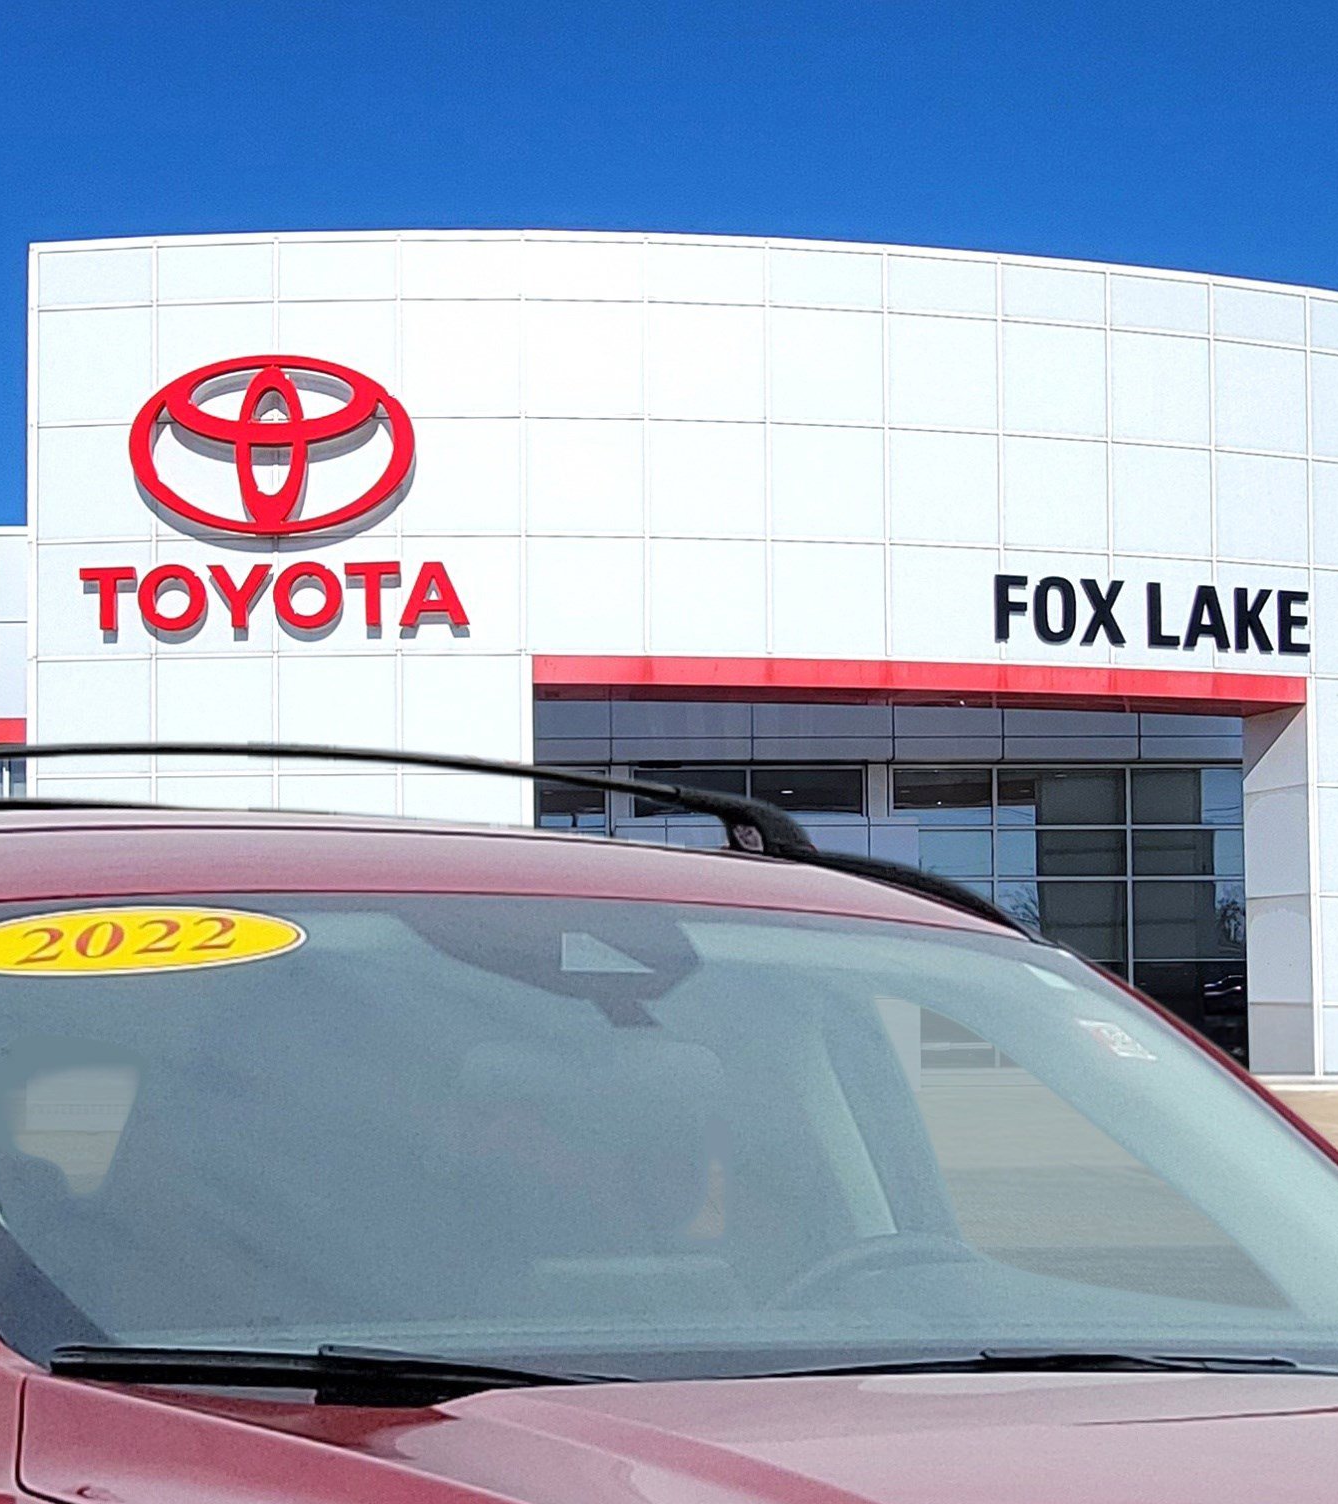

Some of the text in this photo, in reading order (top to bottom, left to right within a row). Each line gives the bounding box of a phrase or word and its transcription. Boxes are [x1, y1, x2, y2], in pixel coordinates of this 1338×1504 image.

[79, 561, 471, 638] TOYOTA
[994, 574, 1311, 656] FOX LAKE
[14, 917, 237, 966] 2022
